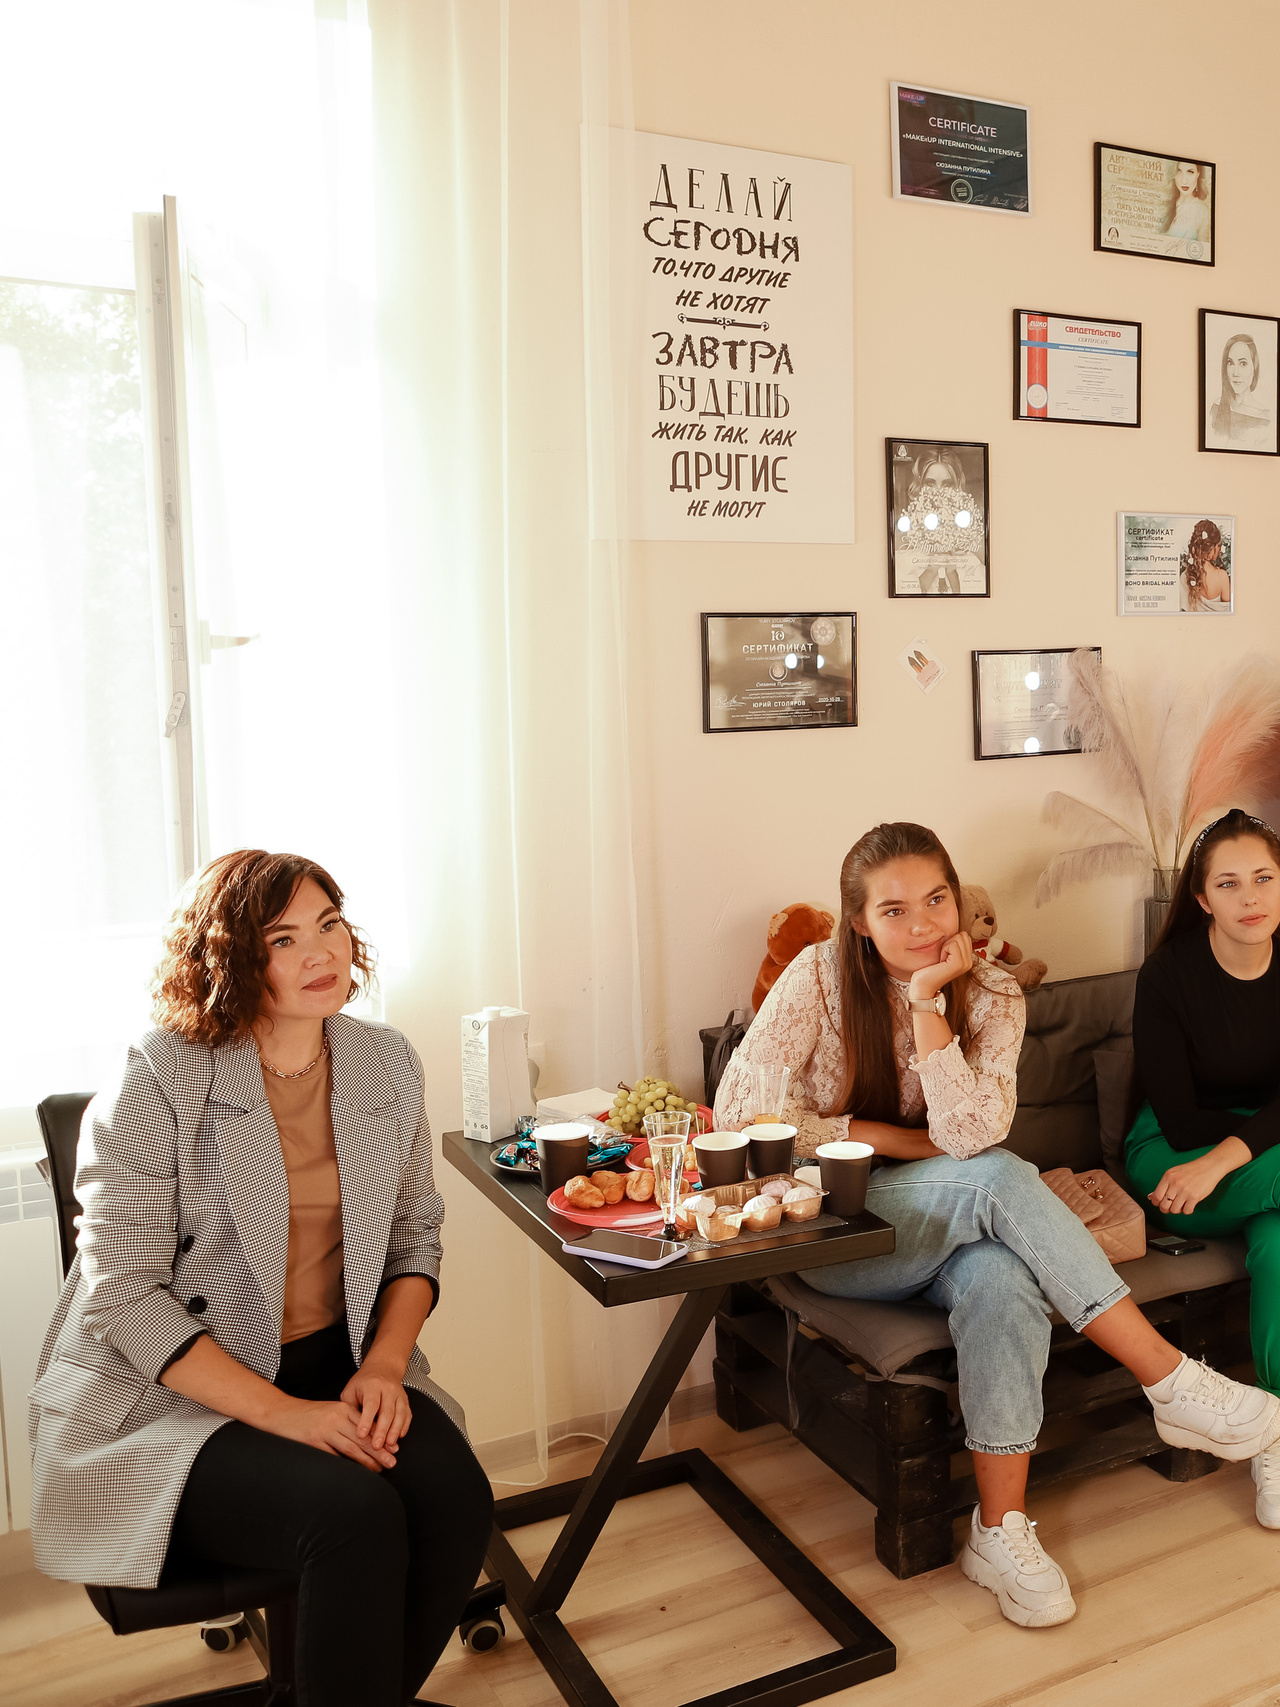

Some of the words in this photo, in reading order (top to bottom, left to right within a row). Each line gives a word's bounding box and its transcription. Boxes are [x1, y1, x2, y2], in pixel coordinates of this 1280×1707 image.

[928, 116, 997, 138] CERTIFICATE
[937, 138, 988, 153] INTERNATIONAL
[935, 161, 963, 171] СЮЗАННА
[1107, 163, 1164, 181] СЕРТФИКАТ
[649, 163, 793, 222] ДЕЛАЙ
[642, 216, 801, 264] СЕГОДНЯ
[651, 257, 716, 281] ТО,ЧТО
[719, 264, 793, 289] ДРУГИЕ
[675, 289, 702, 308] НЕ
[706, 292, 771, 315] ХОТЯТ
[1065, 325, 1121, 339] СВИДЕТЕЛЬСТВО
[1077, 337, 1109, 345] CERTIFICATE
[651, 331, 794, 375] ЗАВТРА
[657, 373, 791, 421] БУДЕШЬ
[651, 421, 707, 442] ЖИТЬ
[758, 428, 798, 448] КАК
[669, 450, 790, 494] ДРУГИЕ
[686, 499, 710, 518] НЕ
[712, 500, 766, 519] МОГУТ
[1128, 527, 1174, 536] СЕРТИФИКАТ
[1150, 554, 1178, 562] Путилина
[742, 643, 814, 654] СЕРТИФИКАТ
